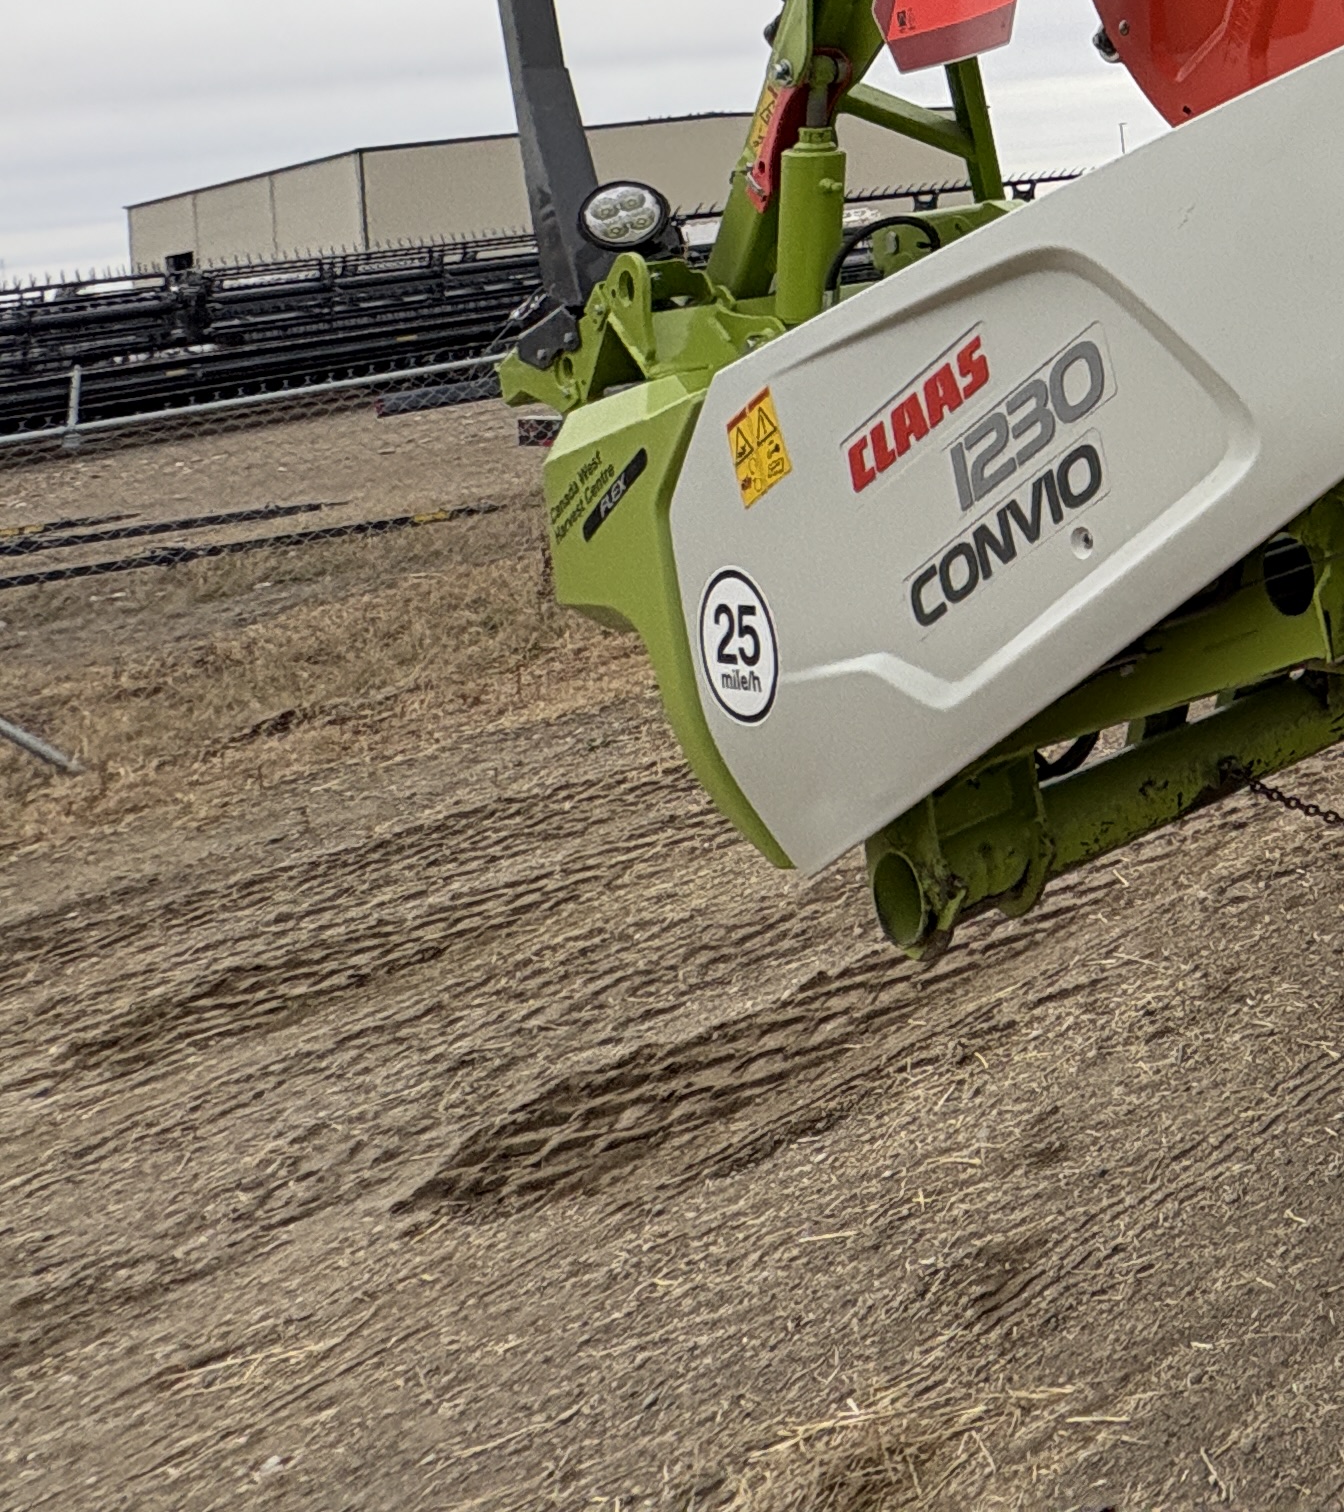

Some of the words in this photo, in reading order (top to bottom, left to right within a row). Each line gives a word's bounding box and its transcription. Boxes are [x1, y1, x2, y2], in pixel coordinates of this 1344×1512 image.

[848, 335, 990, 494] CLAAS
[950, 340, 1104, 512] 1230
[550, 480, 579, 525] Canada
[577, 450, 602, 486] West
[554, 498, 585, 545] Harvest
[584, 464, 615, 505] Centre
[600, 472, 627, 518] FLEX
[911, 444, 1103, 627] CONVIO
[714, 603, 761, 667] 25
[721, 668, 763, 693] mile/h
